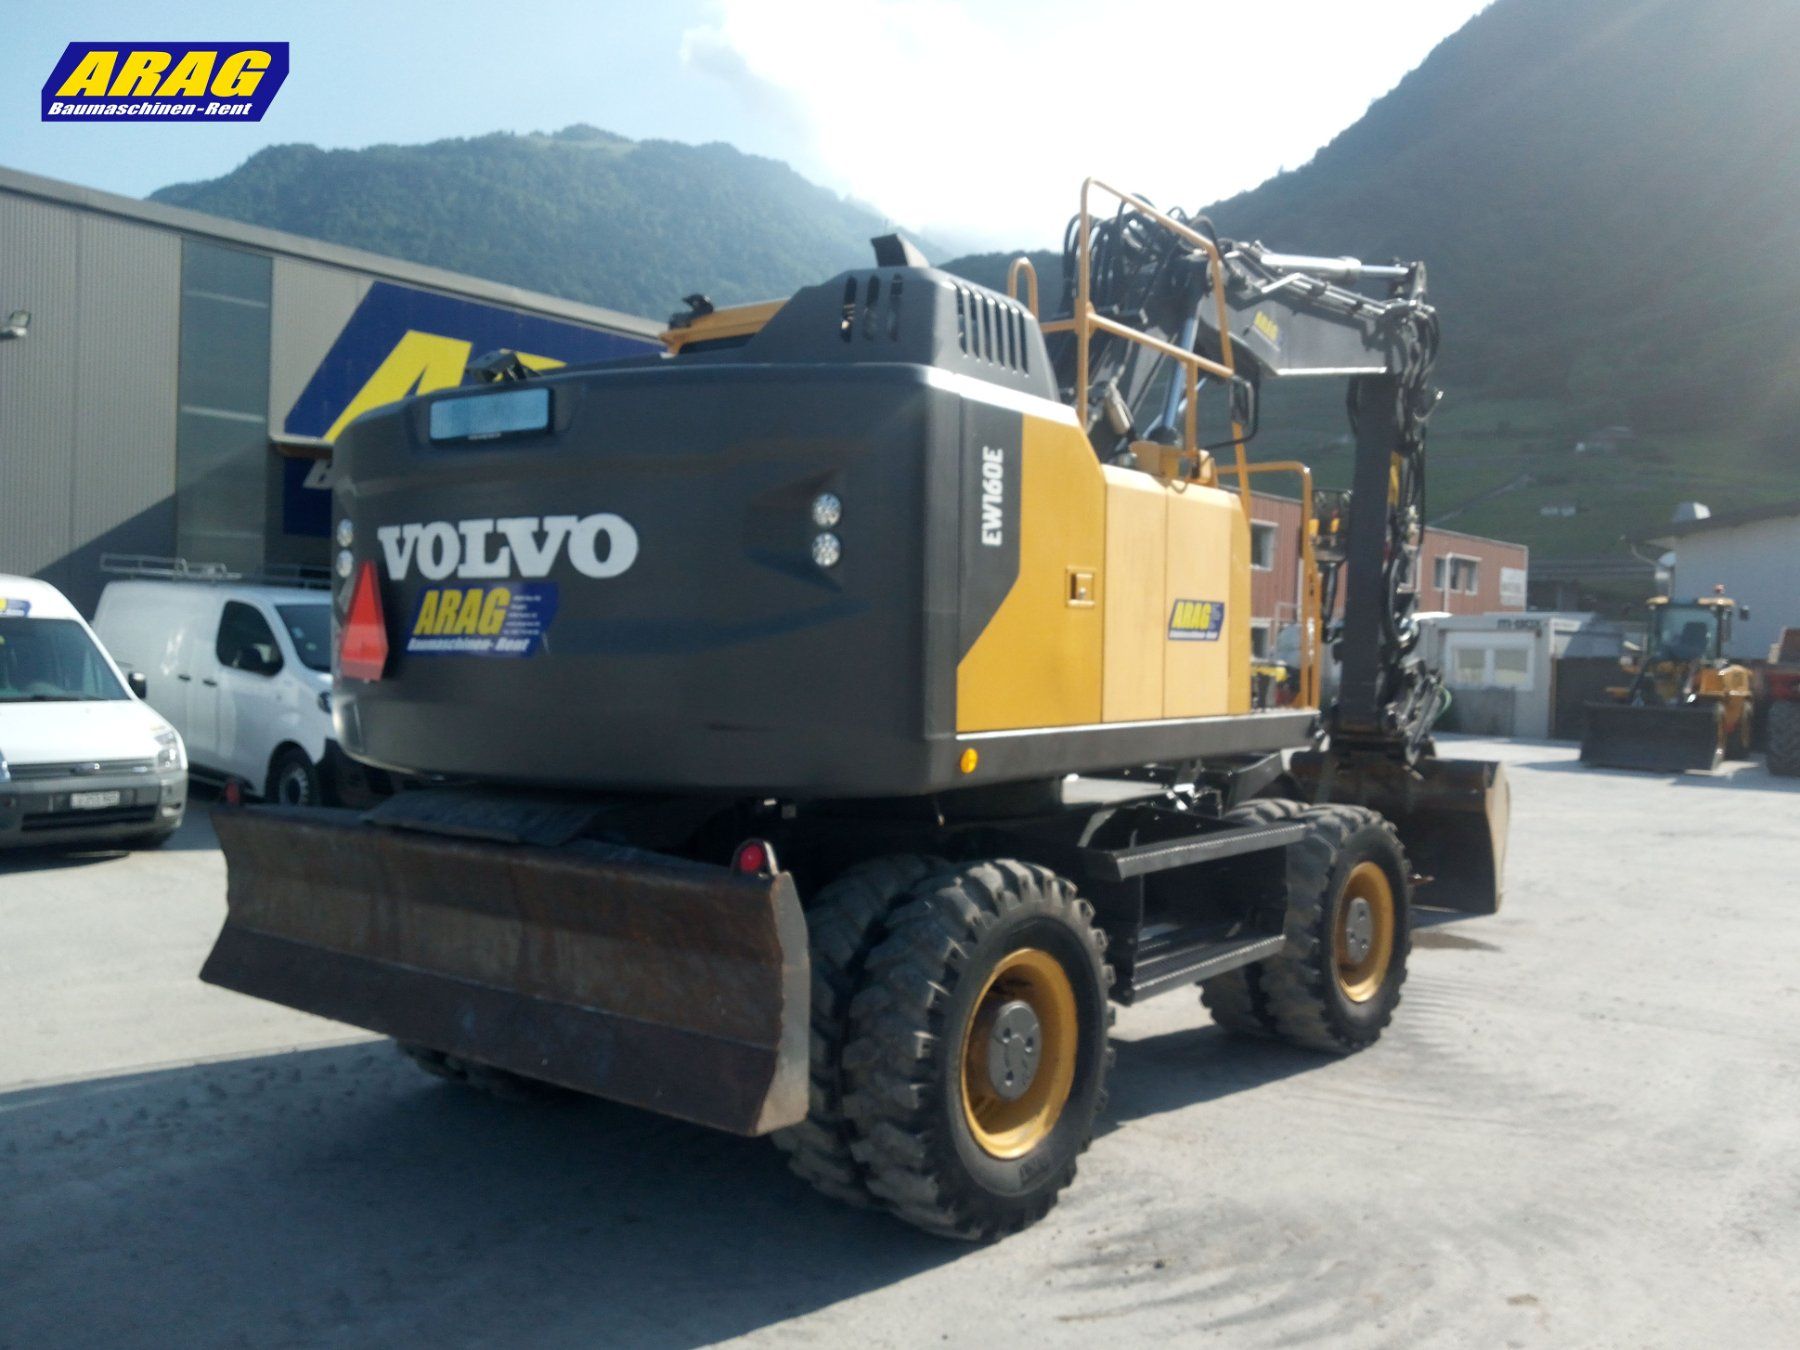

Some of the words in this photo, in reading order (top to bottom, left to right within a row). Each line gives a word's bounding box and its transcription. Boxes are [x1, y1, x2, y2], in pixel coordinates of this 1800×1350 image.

[981, 445, 1004, 546] EW160E
[377, 513, 639, 580] VOLVO
[413, 587, 511, 635] ARAG
[1171, 602, 1212, 630] ARAG
